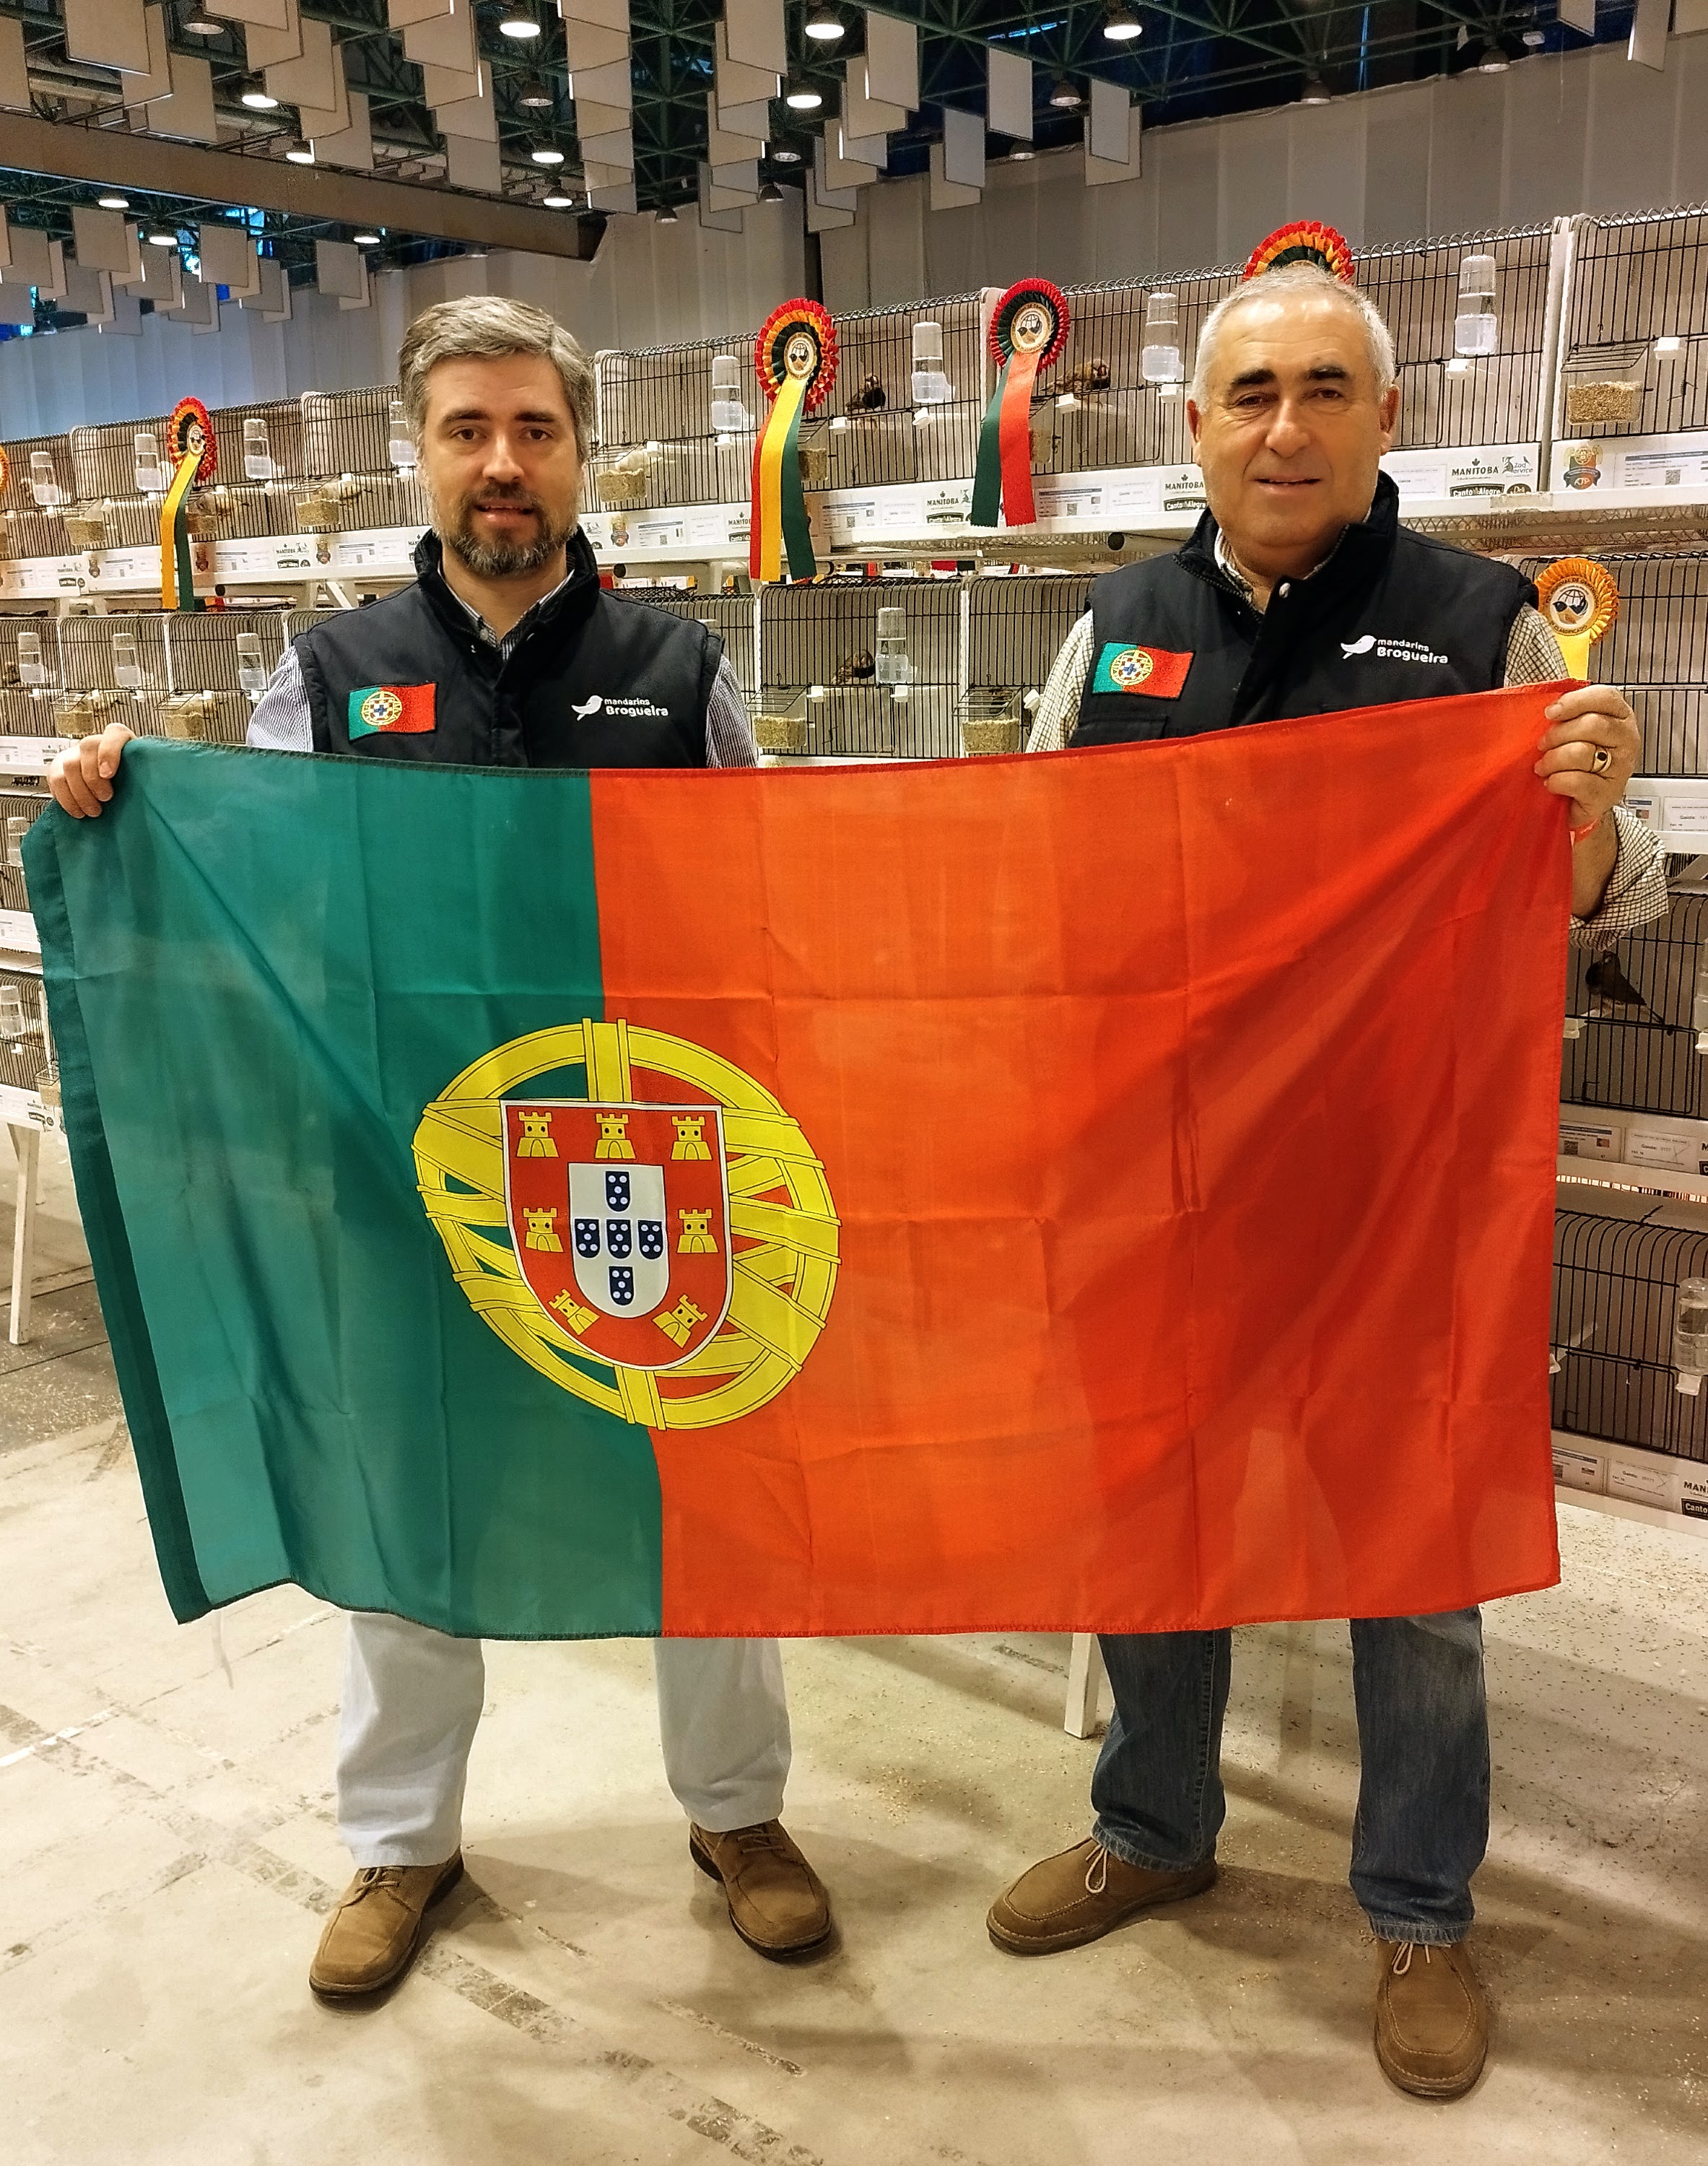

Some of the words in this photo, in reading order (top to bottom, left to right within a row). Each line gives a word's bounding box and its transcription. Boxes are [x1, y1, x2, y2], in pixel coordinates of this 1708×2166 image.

[1452, 466, 1499, 476] MANITOBA
[1164, 481, 1204, 490] MANITOBA
[1377, 639, 1429, 652] mandarins
[1377, 646, 1448, 664] Brogueira
[605, 705, 668, 717] Brogueira
[1683, 1481, 1708, 1493] MAN
[1686, 1502, 1708, 1513] Canto
